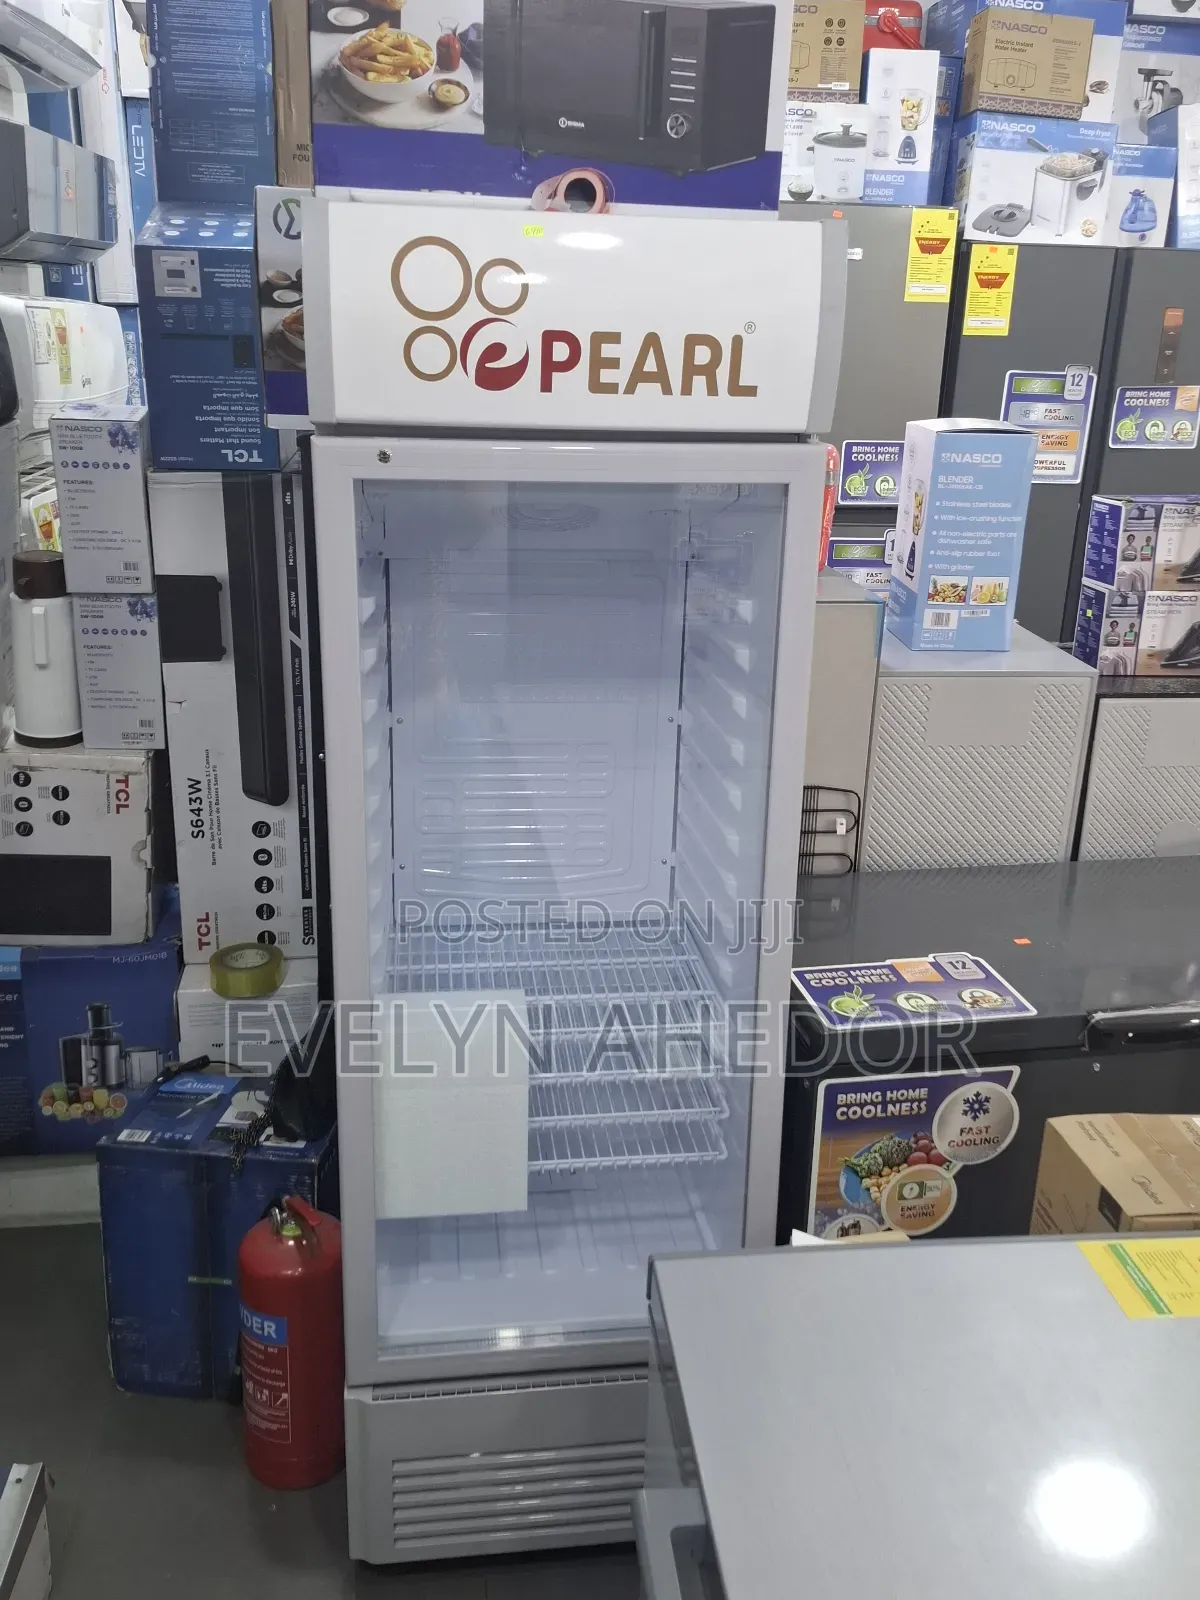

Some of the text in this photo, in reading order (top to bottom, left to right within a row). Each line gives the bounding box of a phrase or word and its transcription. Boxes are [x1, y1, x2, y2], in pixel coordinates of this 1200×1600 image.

[1001, 21, 1047, 35] NASCO
[785, 108, 812, 116] SCO
[991, 122, 1036, 134] NASCO
[1080, 127, 1096, 136] Deep
[872, 174, 905, 183] NASCO
[865, 188, 894, 196] BLENDER
[539, 329, 758, 398] PEARL
[1070, 373, 1084, 387] 12
[1125, 390, 1148, 398] BRING
[1124, 398, 1170, 406] COOLNESS
[64, 425, 103, 433] NASCO
[1041, 433, 1069, 441] ENERGY
[852, 445, 876, 453] BRING
[221, 449, 263, 463] TCL
[851, 453, 899, 462] COOLNESS
[950, 453, 1002, 464] NASCO
[938, 475, 974, 484] BLENDER
[1156, 595, 1198, 603] NASCO
[115, 775, 129, 815] TCL
[187, 777, 205, 839] S643W
[260, 880, 268, 892] dts
[196, 912, 211, 950] TCL
[948, 960, 972, 970] 12
[803, 967, 892, 981] BRING HOME
[809, 974, 898, 988] COOLNESS
[836, 1087, 929, 1106] BRING HOME
[836, 1100, 927, 1121] COOLNESS
[959, 1125, 992, 1136] FAST
[947, 1136, 1000, 1148] COOLING
[900, 1203, 936, 1213] ENERGY
[900, 1211, 936, 1220] SAVING
